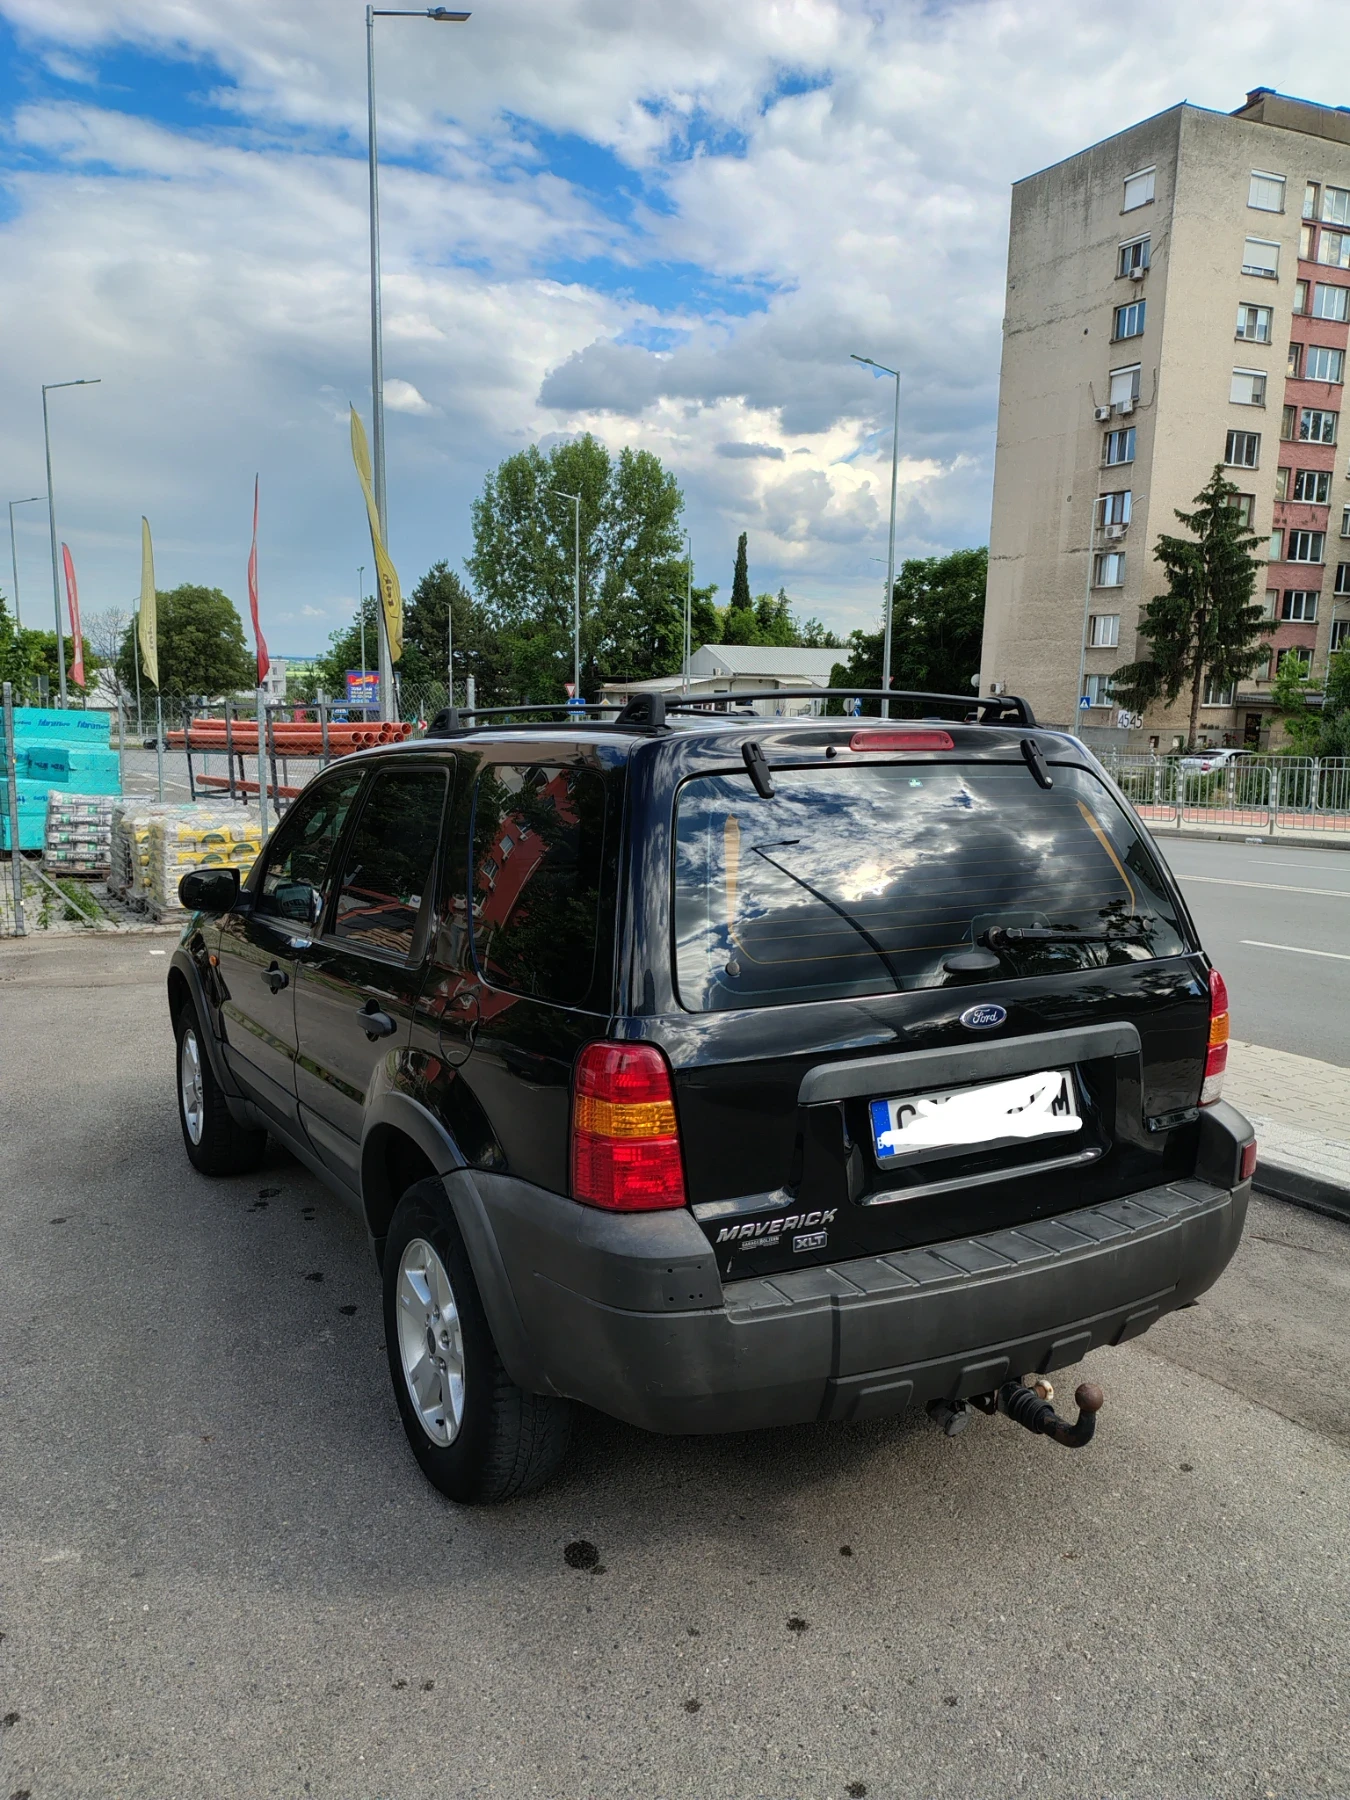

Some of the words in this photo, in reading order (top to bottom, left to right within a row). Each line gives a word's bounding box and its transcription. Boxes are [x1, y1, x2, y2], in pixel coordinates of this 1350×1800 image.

[1118, 713, 1130, 728] 45
[972, 1008, 998, 1024] Ford
[716, 1208, 838, 1243] MAVERICK
[796, 1235, 824, 1249] XLT
